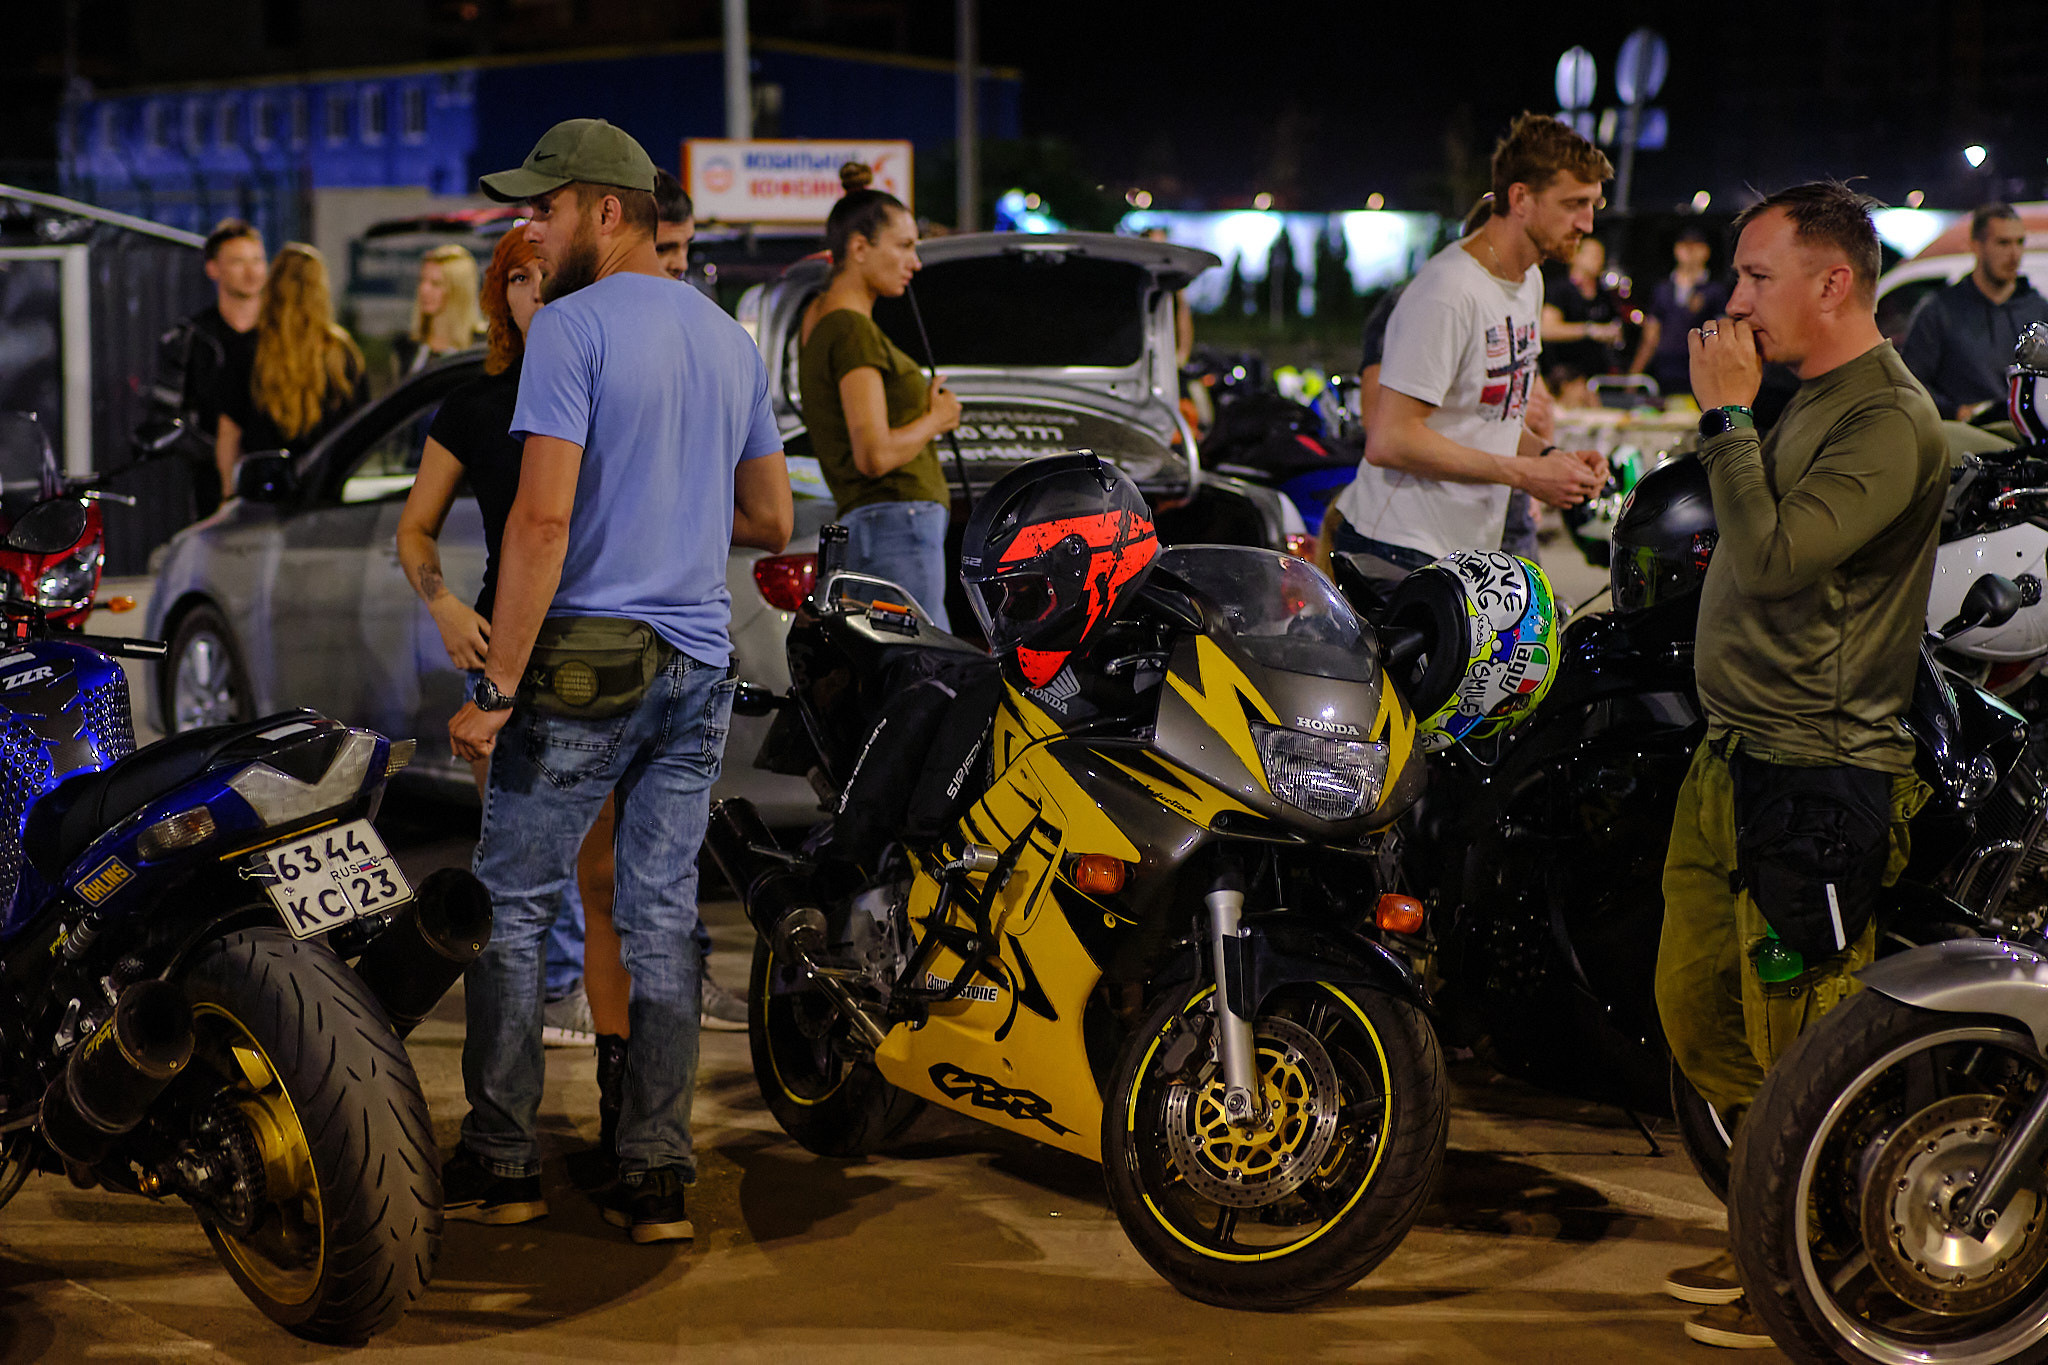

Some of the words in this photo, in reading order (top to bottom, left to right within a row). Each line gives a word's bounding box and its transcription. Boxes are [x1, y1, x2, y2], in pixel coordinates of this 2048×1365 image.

[2, 665, 55, 690] ZZR
[1460, 663, 1491, 714] SMILE
[1503, 647, 1532, 691] agv
[1296, 716, 1360, 736] HONDA
[278, 830, 370, 881] 6344
[331, 864, 360, 882] RUS
[352, 868, 398, 907] 23
[928, 1062, 1082, 1137] CBR
